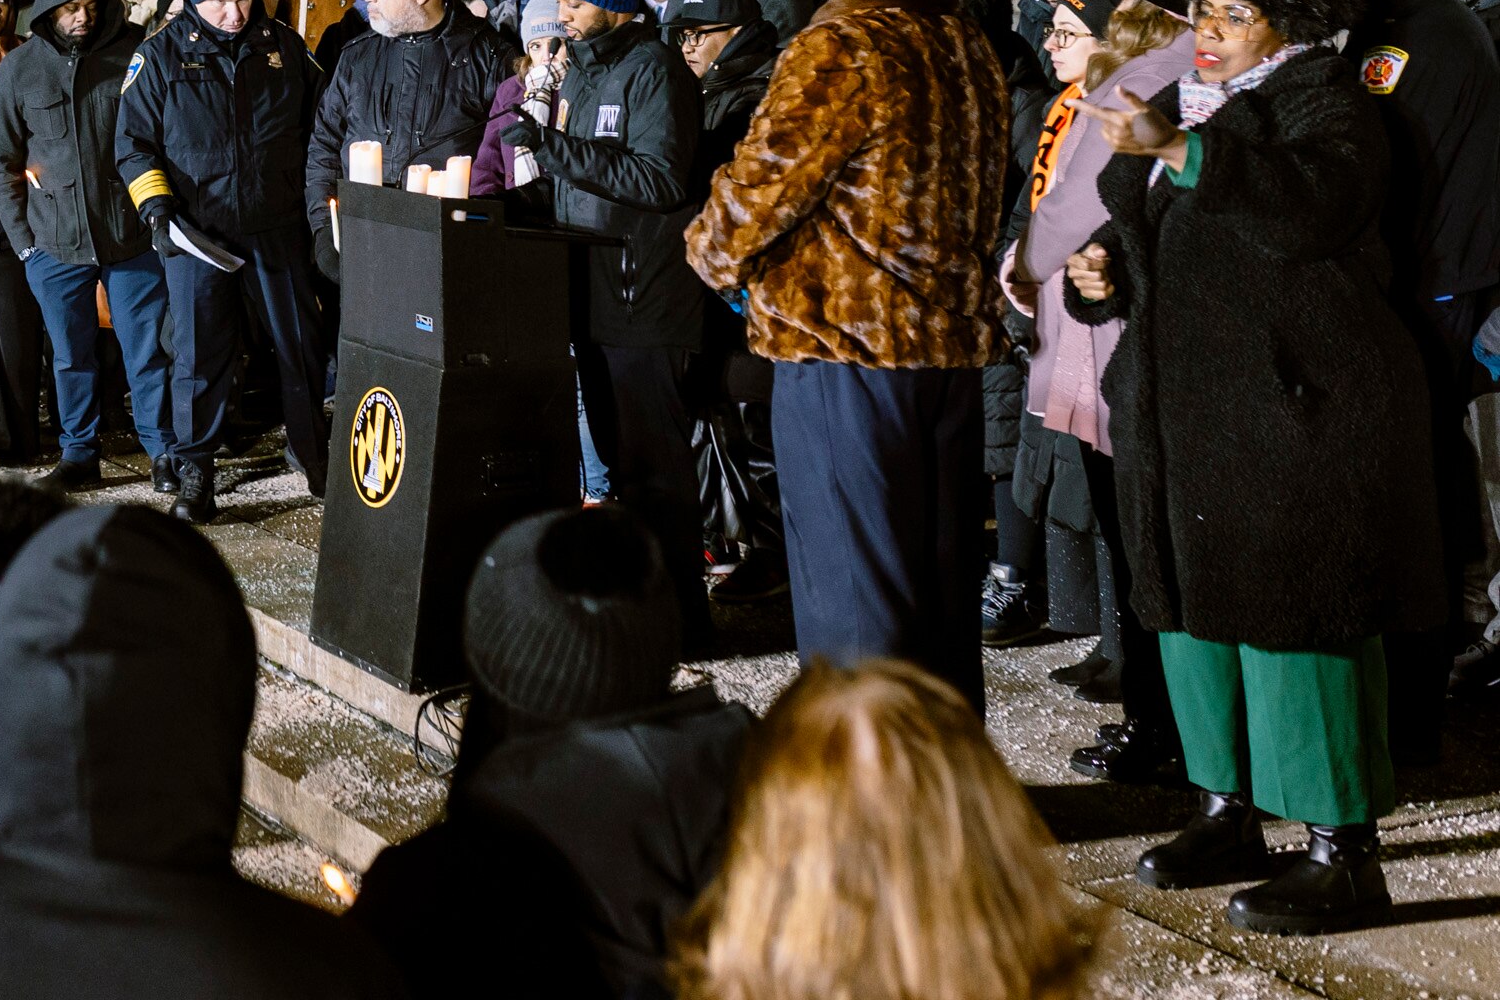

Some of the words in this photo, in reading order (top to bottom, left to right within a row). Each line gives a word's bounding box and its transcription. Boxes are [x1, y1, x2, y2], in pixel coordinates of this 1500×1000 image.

[531, 22, 567, 35] BALTIMO
[356, 404, 367, 431] CITY
[366, 394, 376, 408] OF
[376, 392, 402, 449] BALTIMORE
